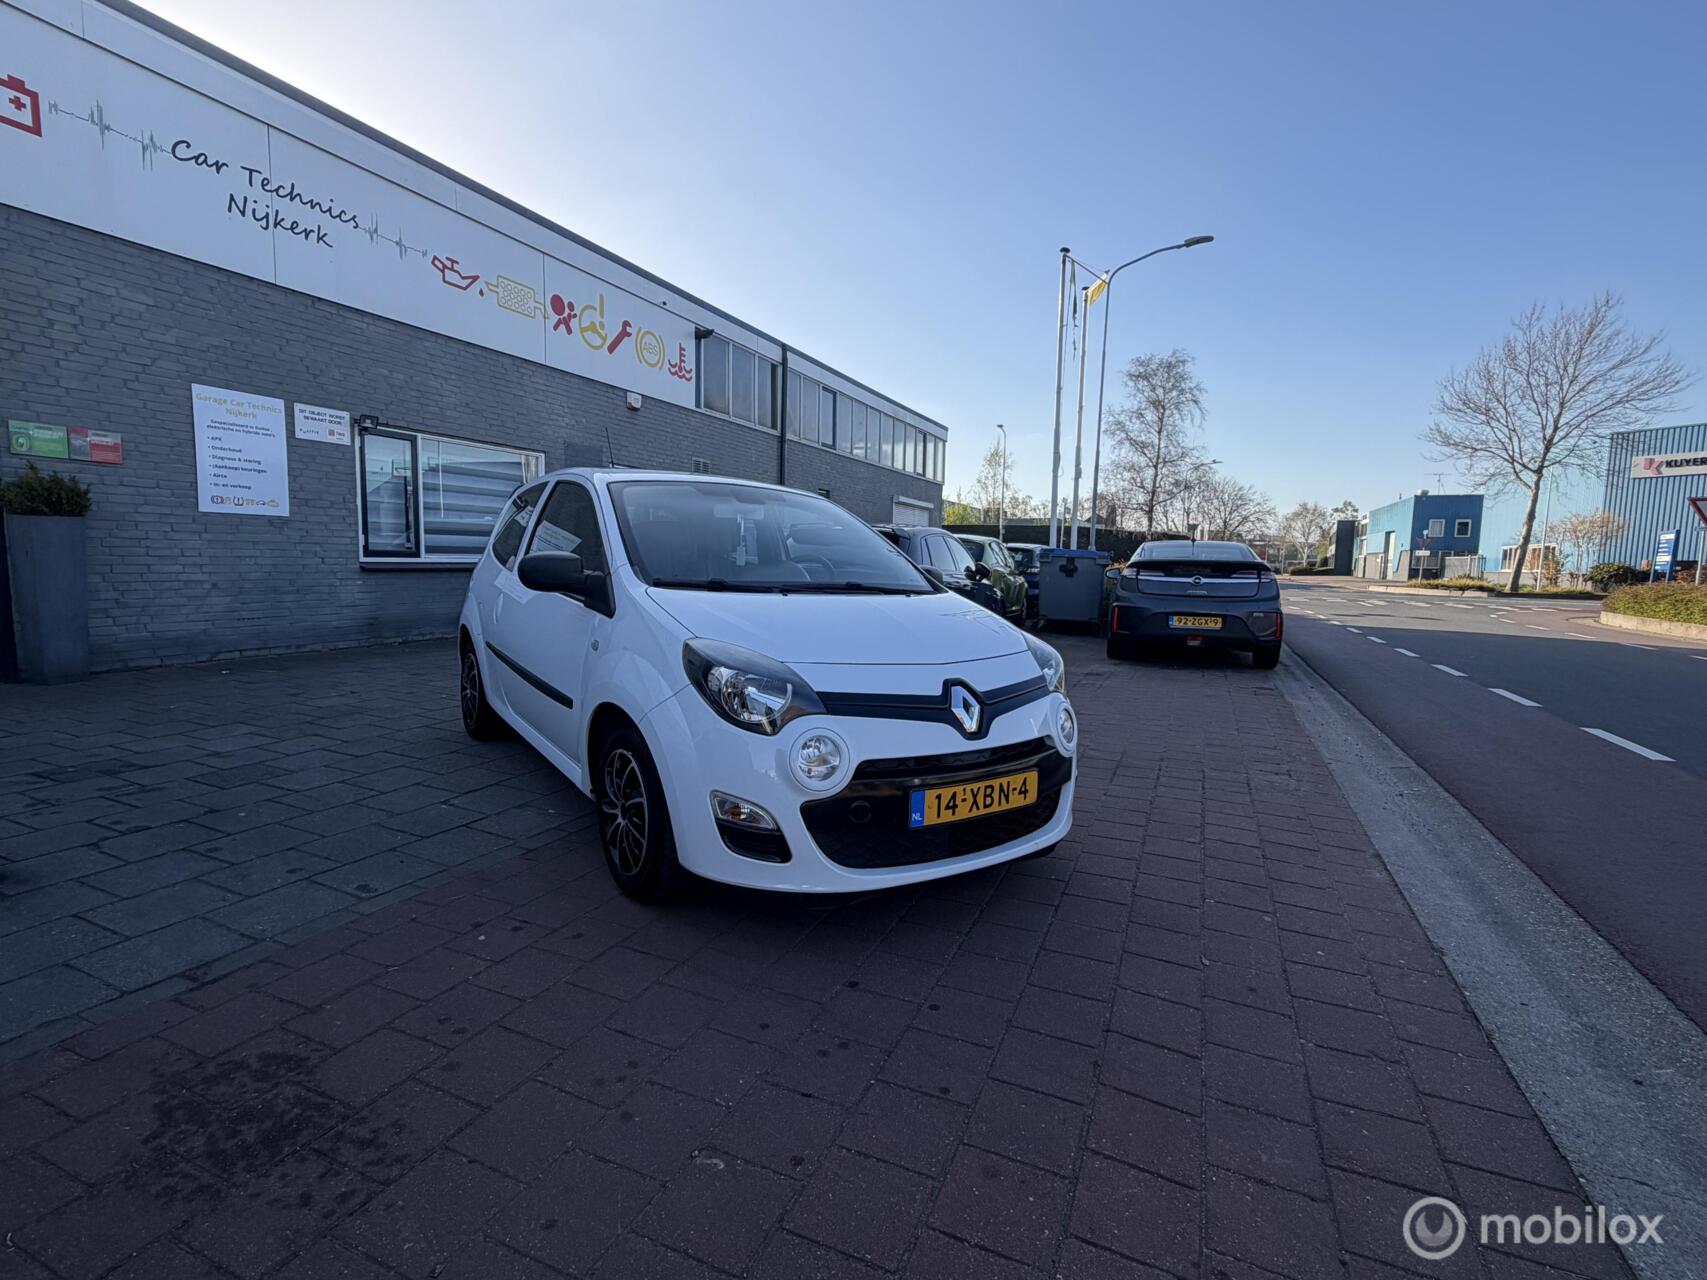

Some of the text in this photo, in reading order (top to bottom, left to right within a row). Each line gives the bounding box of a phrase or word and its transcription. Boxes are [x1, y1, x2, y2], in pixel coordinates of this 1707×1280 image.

[171, 139, 361, 230] Car Technics
[227, 193, 333, 249] Nijkerk
[643, 341, 658, 356] ABS
[196, 393, 282, 414] Garage Car Technics
[225, 408, 257, 419] Nijkerk
[211, 445, 242, 453] Onderhoud
[1176, 618, 1219, 626] 92-ZGX-9
[911, 776, 1029, 821] NL 14-XBN-4
